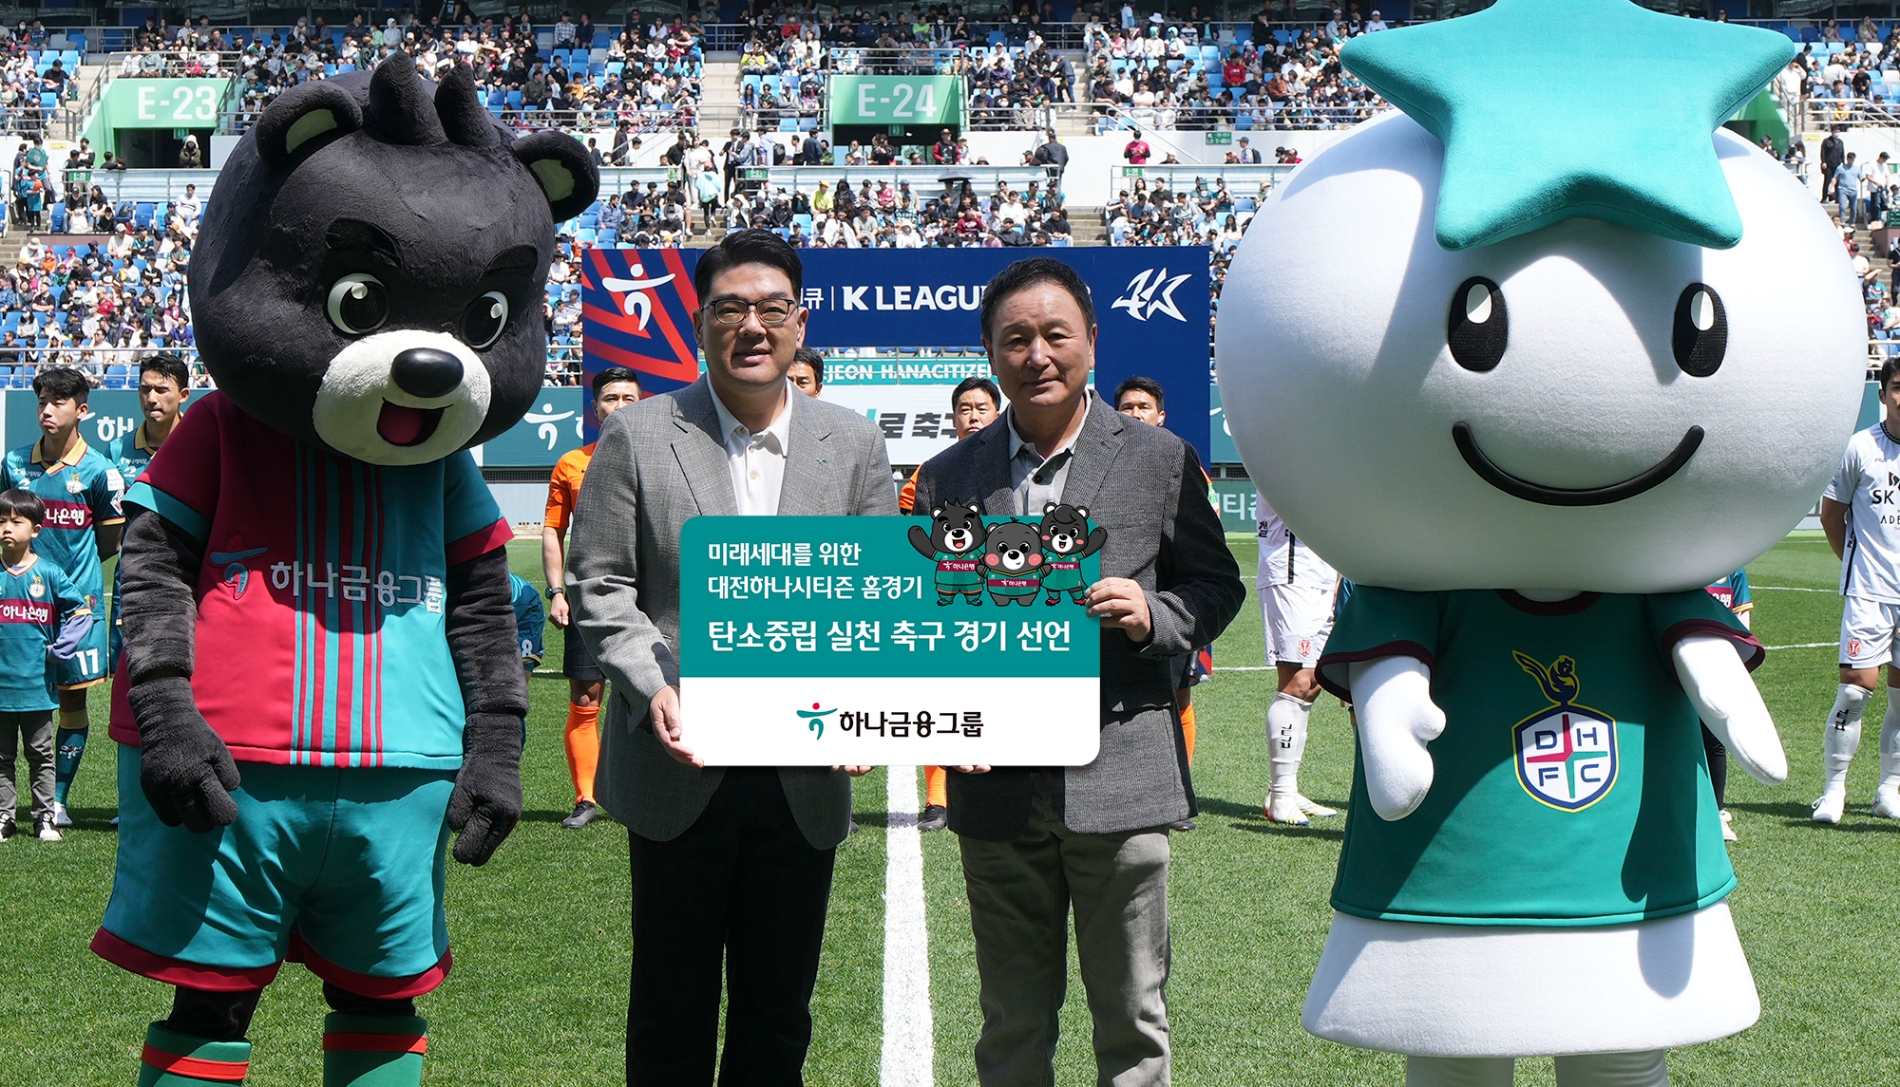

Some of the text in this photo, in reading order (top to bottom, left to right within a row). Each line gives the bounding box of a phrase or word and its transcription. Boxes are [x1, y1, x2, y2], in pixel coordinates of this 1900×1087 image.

[138, 86, 217, 120] E-23
[858, 83, 937, 117] E-24
[842, 286, 869, 310] K
[875, 285, 987, 311] LEAGU
[1872, 489, 1895, 505] SK
[45, 507, 85, 526] 나은행
[708, 542, 862, 566] 미래세대를 위한
[270, 560, 443, 614] 하나금융그룹
[707, 575, 922, 599] 대전하나시티즌 홈경기
[3, 605, 49, 623] 하나은행
[708, 620, 1070, 652] 탄소중립 실천 축구 경기 선언
[76, 648, 99, 676] 17
[839, 711, 984, 738] 하나금융그룹
